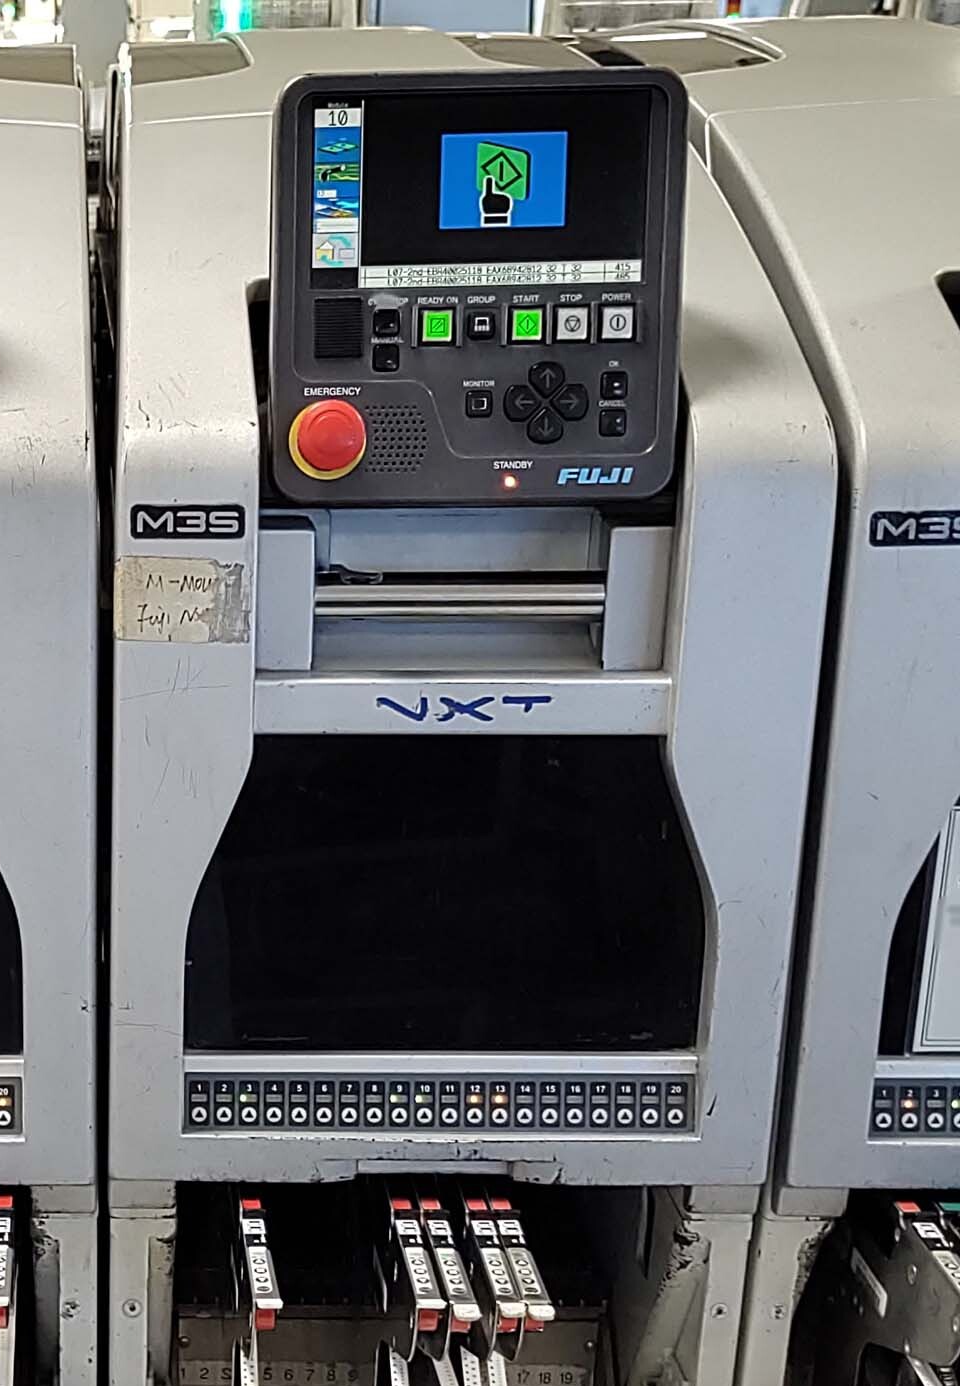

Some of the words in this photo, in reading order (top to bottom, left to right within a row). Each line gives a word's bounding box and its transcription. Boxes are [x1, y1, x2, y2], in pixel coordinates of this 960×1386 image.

[329, 110, 348, 127] 10
[417, 296, 444, 304] READY
[446, 296, 458, 304] ON
[467, 296, 496, 304] GROUP
[513, 295, 540, 303] START
[560, 294, 583, 302] STOP
[601, 293, 631, 301] POWER
[463, 380, 496, 388] MONITOR
[304, 387, 361, 397] EMERGENCY
[493, 460, 533, 470] STANDBY
[557, 468, 634, 485] FUJI
[137, 511, 240, 533] M3S
[200, 1367, 209, 1380] 2
[263, 1367, 272, 1381] 5
[284, 1368, 294, 1381] 6
[305, 1368, 315, 1381] 7
[326, 1368, 336, 1381] 8
[517, 1370, 530, 1384] 17
[539, 1372, 551, 1384] 18
[561, 1371, 573, 1384] 19
